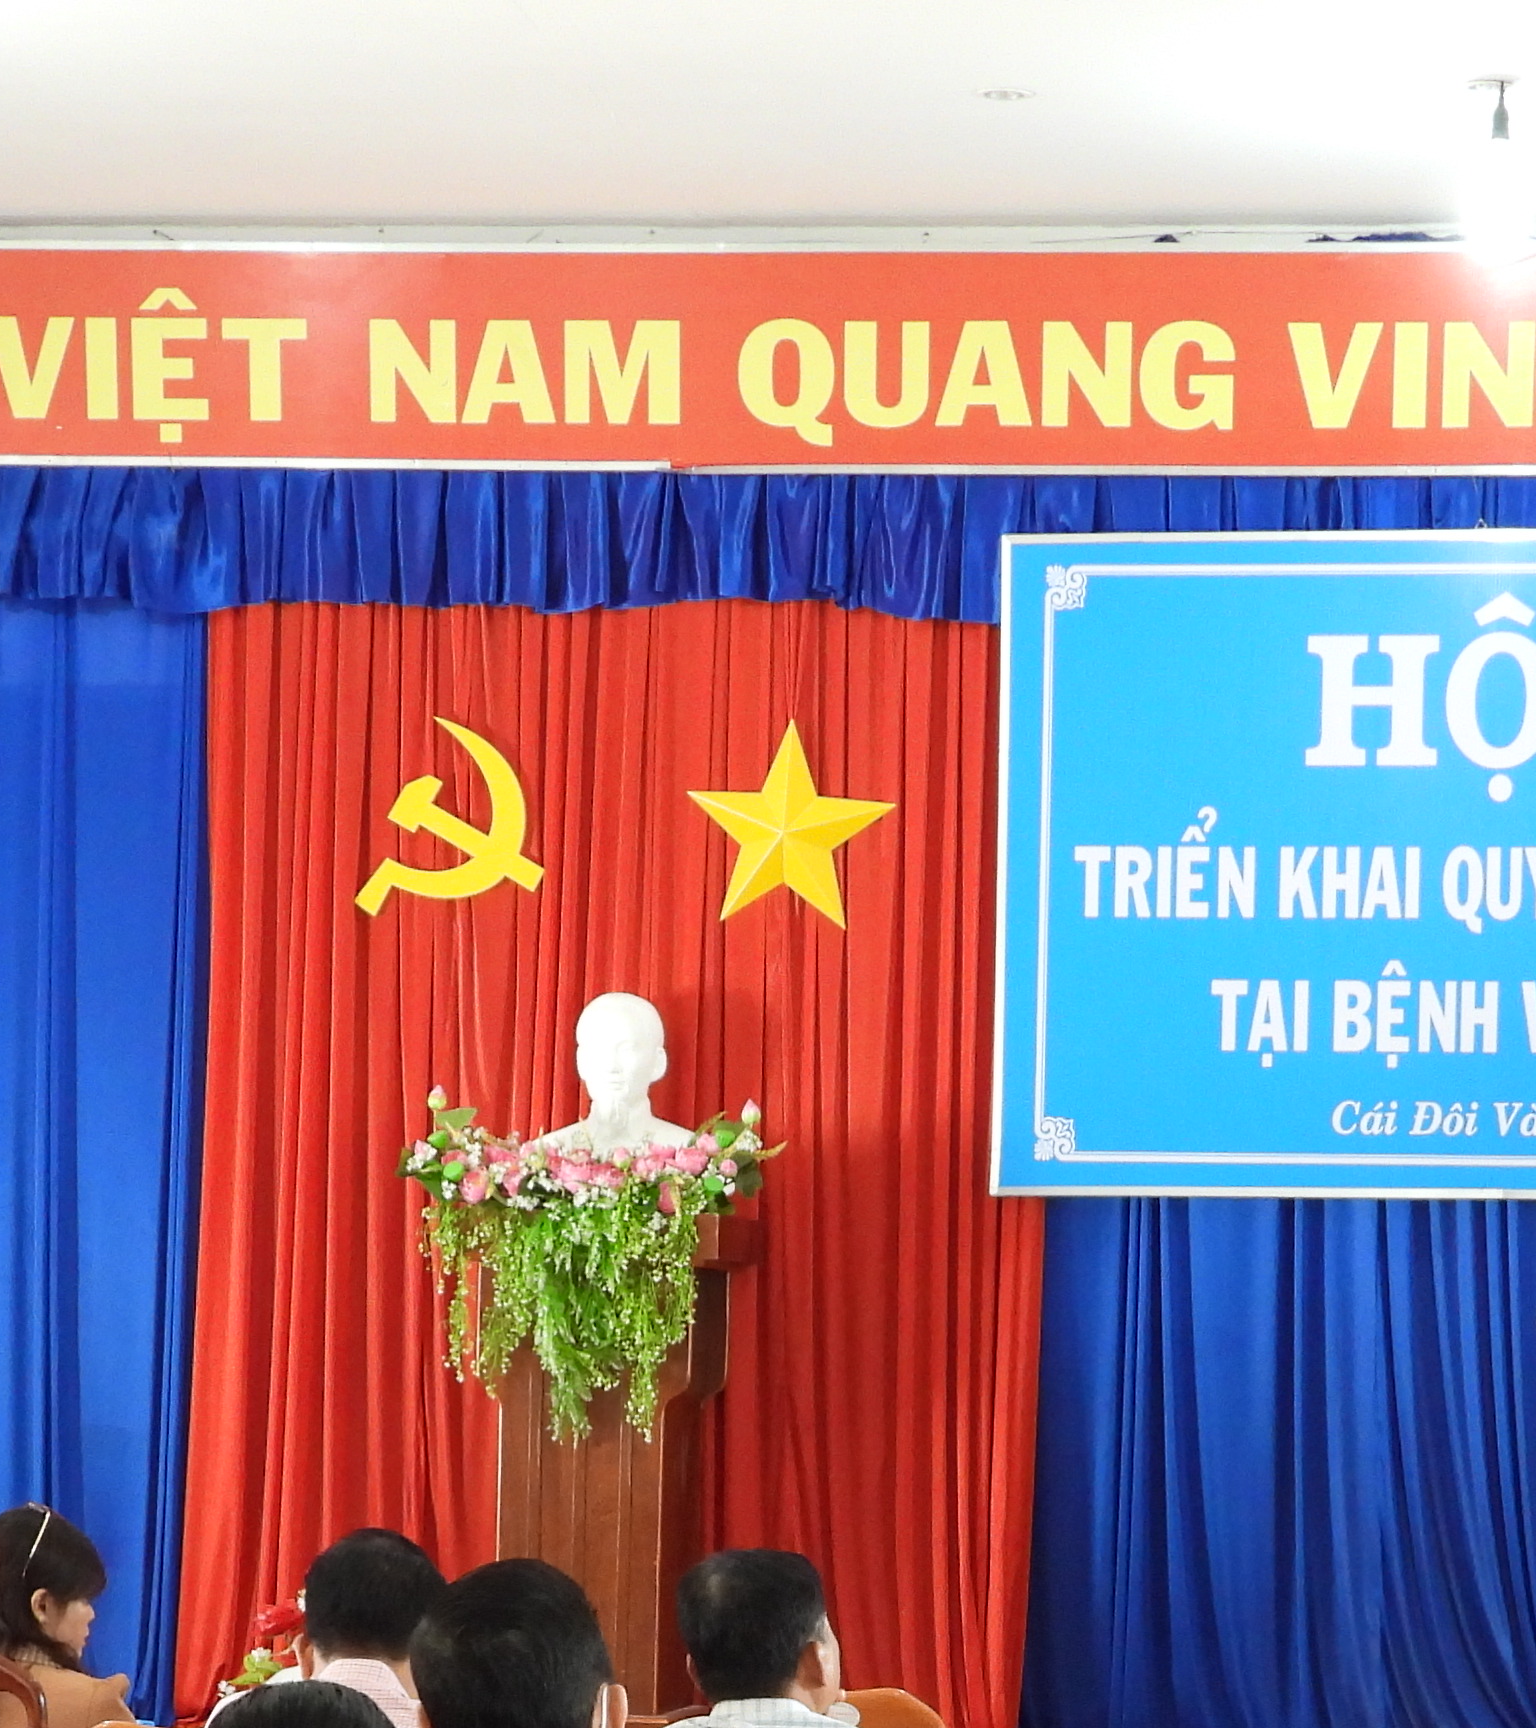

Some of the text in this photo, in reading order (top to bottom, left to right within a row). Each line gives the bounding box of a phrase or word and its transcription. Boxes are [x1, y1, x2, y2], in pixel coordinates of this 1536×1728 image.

[368, 318, 683, 424] NAM
[735, 317, 1238, 445] QUANG
[1075, 806, 1255, 918] TRIỂN
[1279, 846, 1420, 919] KHAI
[1211, 979, 1309, 1067] TẠI
[1333, 960, 1499, 1068] BỆNH
[1332, 1101, 1397, 1135] Cái
[1409, 1102, 1478, 1135] Đôi
